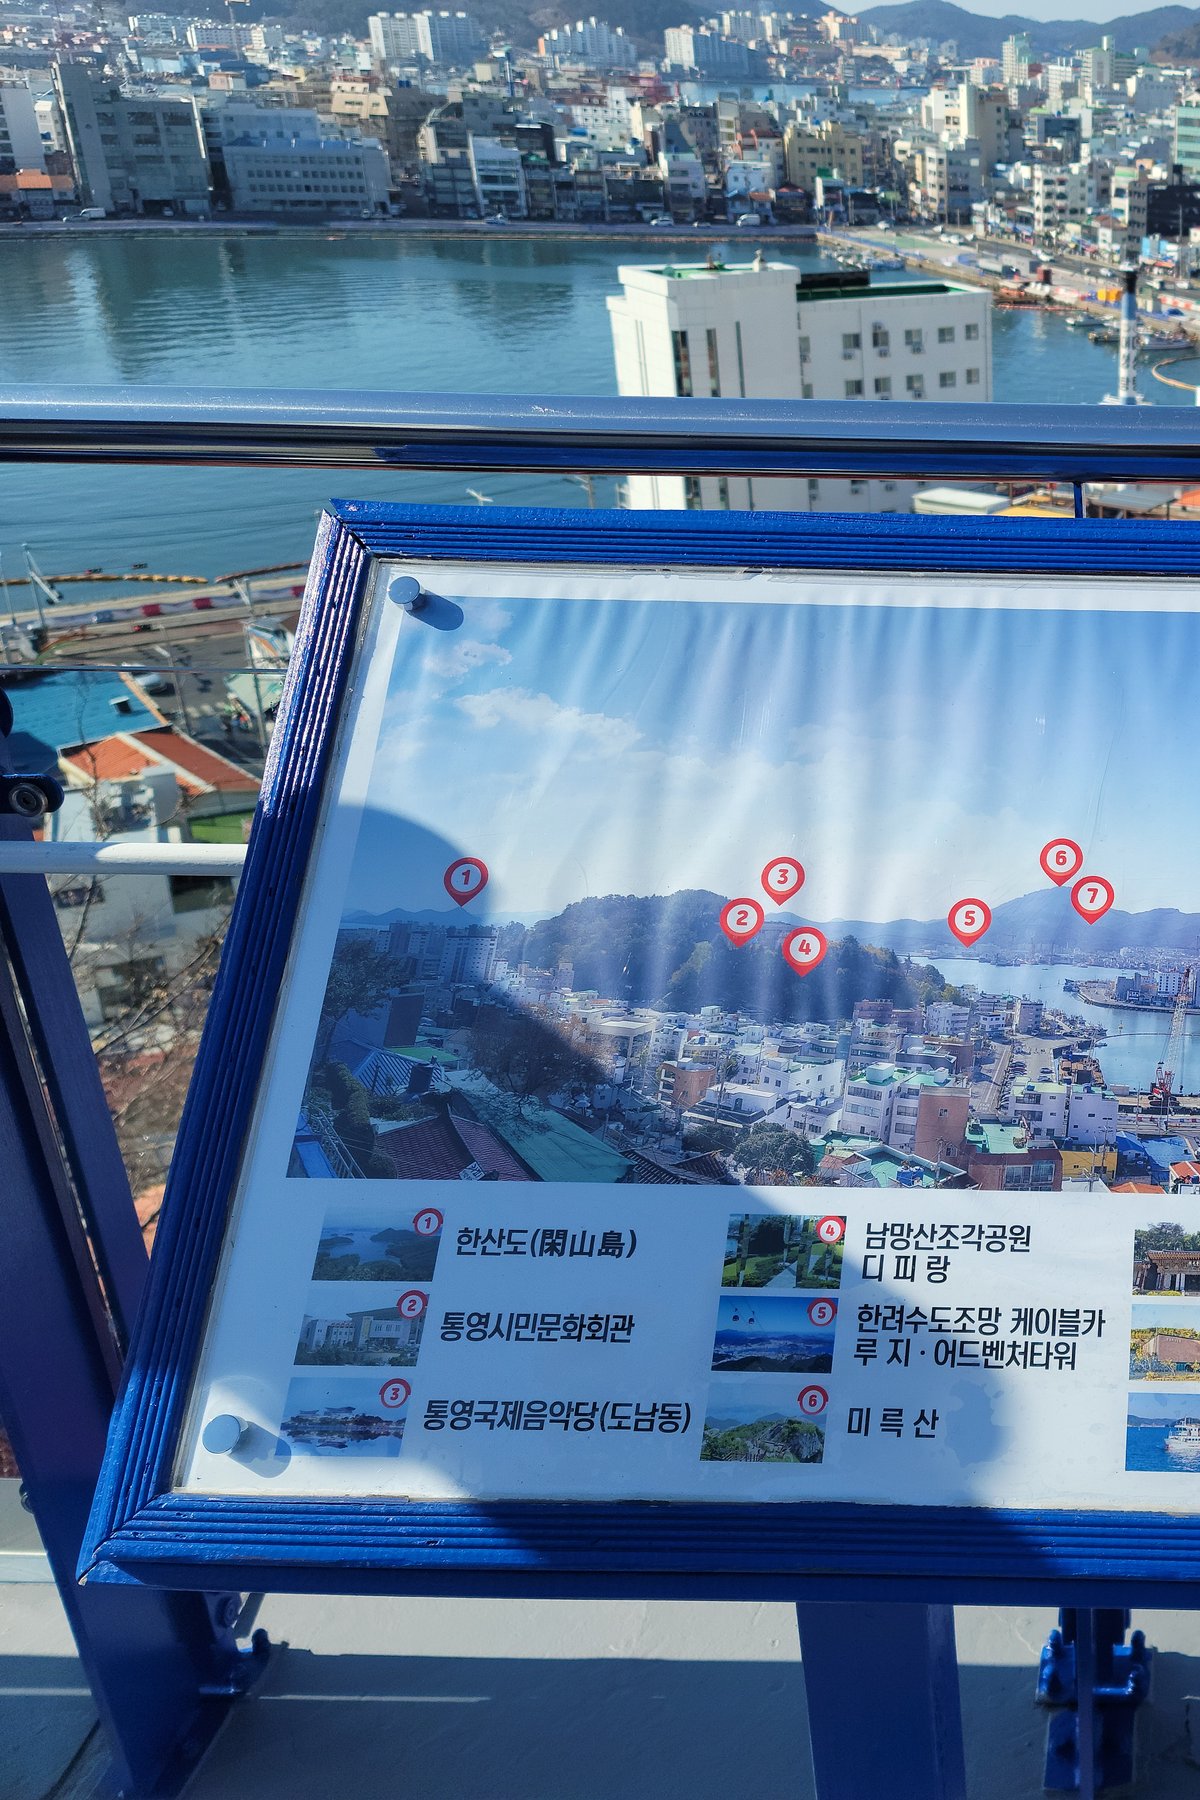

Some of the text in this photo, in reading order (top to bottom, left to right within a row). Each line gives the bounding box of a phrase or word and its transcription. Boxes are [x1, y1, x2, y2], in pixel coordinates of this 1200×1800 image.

[1055, 850, 1067, 866] 6
[461, 869, 471, 884] 1
[776, 868, 789, 884] 3
[1087, 887, 1099, 903] 7
[736, 910, 749, 925] 2
[964, 910, 976, 926] 5
[798, 939, 812, 954] 4
[424, 1216, 432, 1230] 1
[825, 1224, 835, 1237] 4
[865, 1222, 1031, 1252] 남망산조각공원
[407, 1298, 417, 1312] 2
[817, 1306, 827, 1320] 5
[857, 1304, 1105, 1336] 한려수도조망 케이블카
[440, 1311, 635, 1342] 통영시민문화회관
[934, 1339, 1076, 1369] 어드벤처타워
[389, 1387, 400, 1401] 3
[808, 1394, 818, 1408] 6
